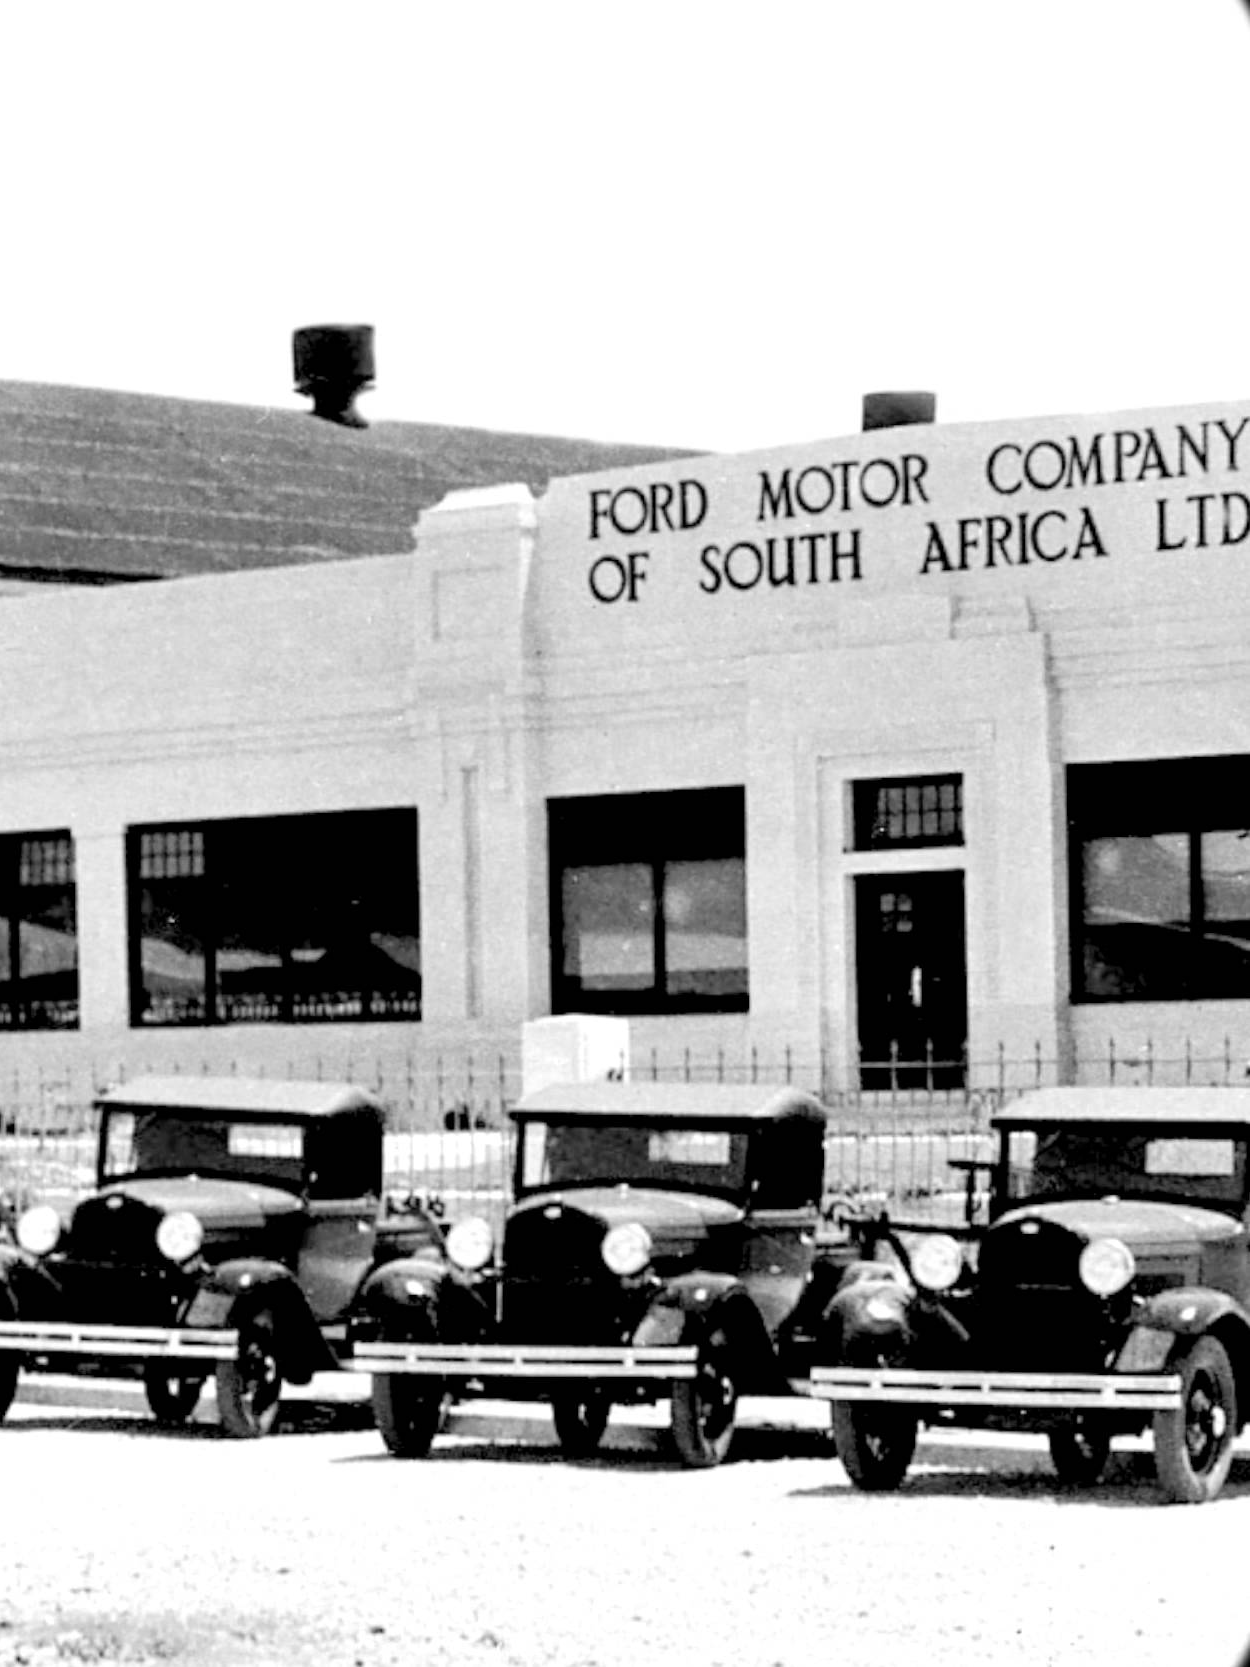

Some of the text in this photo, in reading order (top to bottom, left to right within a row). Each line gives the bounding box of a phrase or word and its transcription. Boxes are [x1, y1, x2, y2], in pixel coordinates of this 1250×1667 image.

[589, 417, 1250, 539] FORD MOTOR COMPANY
[588, 552, 649, 604] OF
[699, 529, 863, 594] SOUTH
[919, 507, 1108, 574] AFRICA
